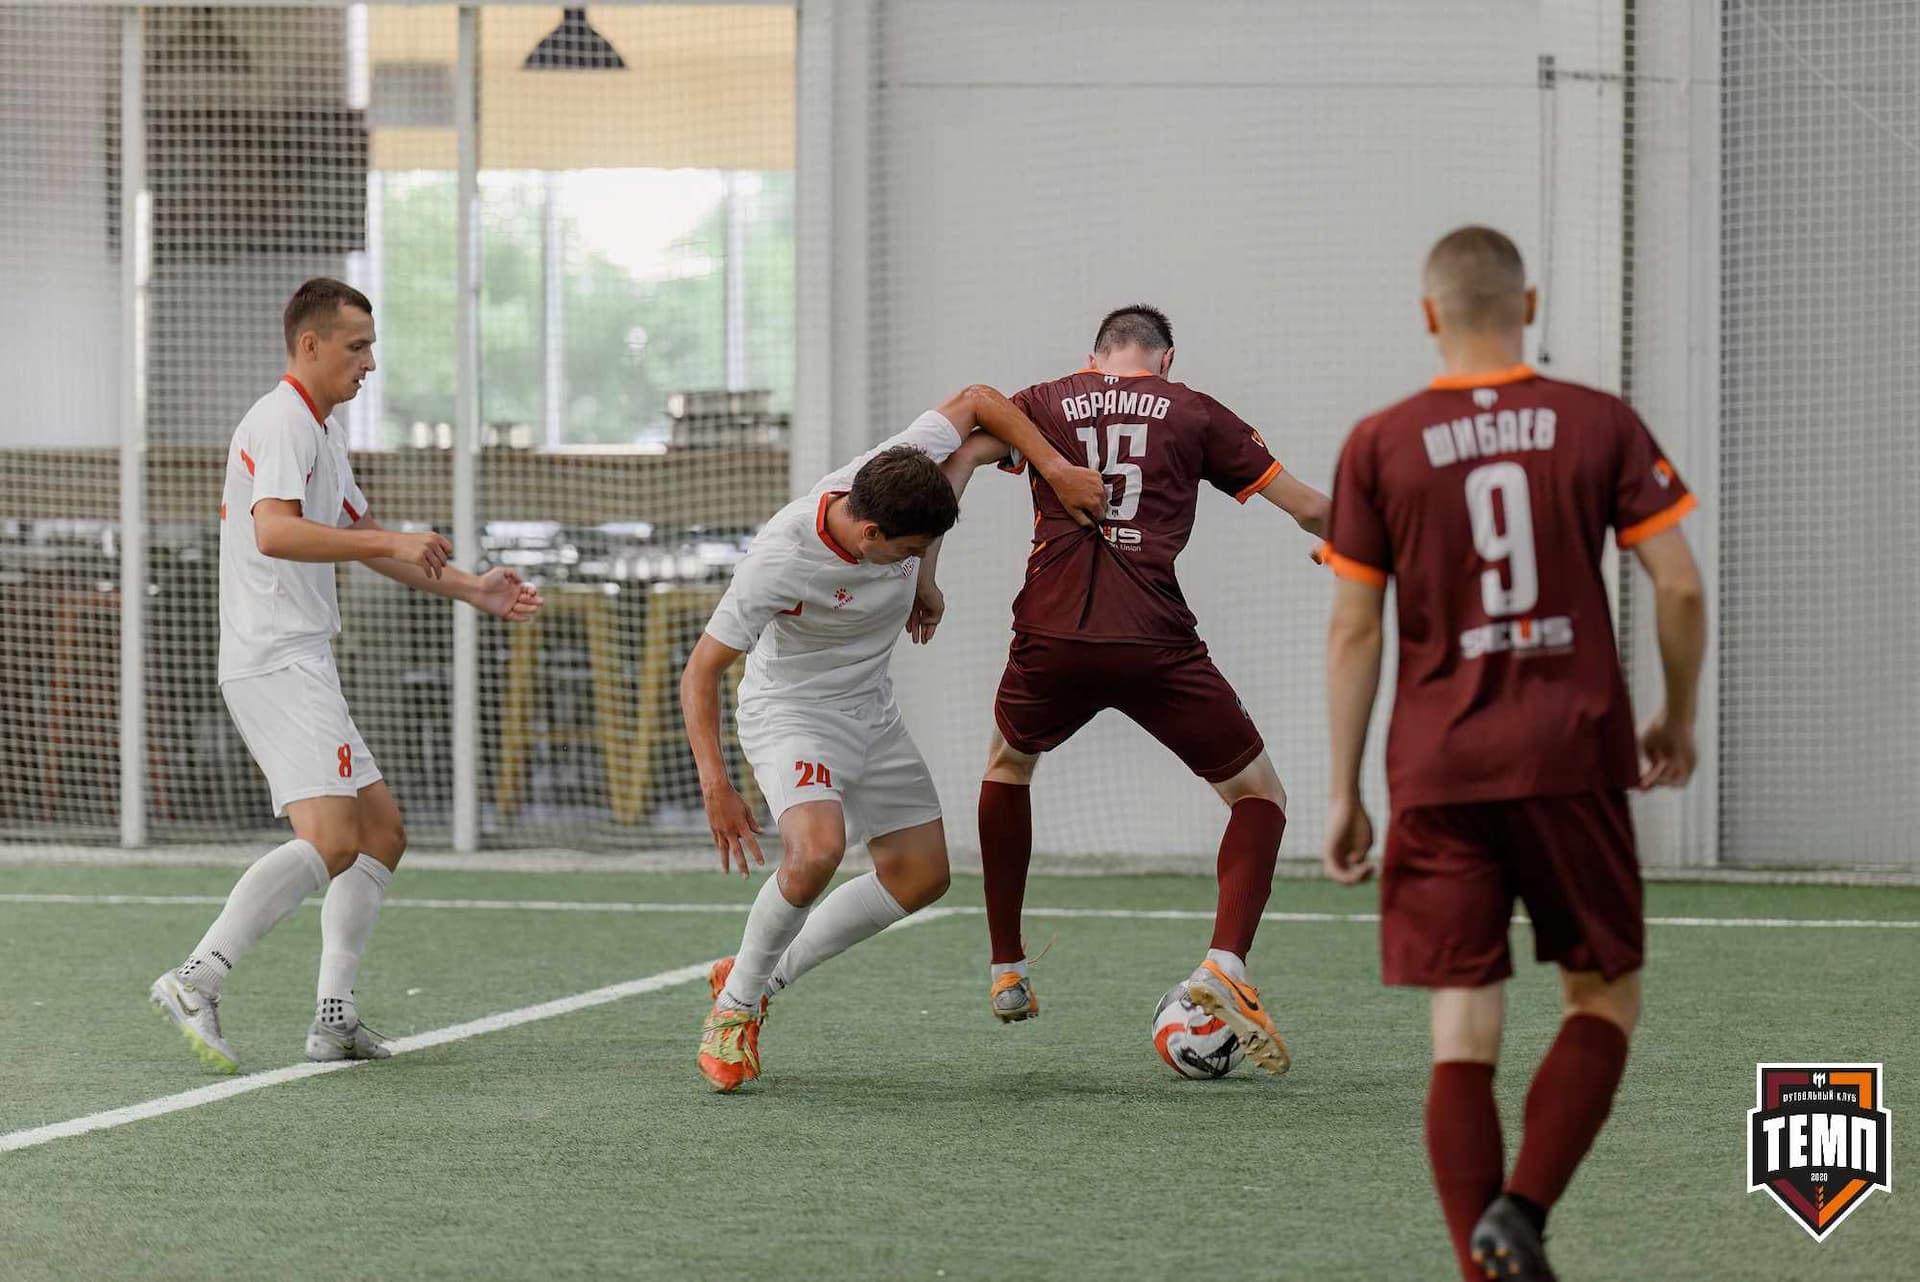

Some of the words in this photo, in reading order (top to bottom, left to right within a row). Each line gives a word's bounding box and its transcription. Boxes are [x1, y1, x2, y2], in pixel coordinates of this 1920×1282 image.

[1061, 389, 1171, 422] АБРАМОВ
[1423, 408, 1557, 469] ШИБАЕВ
[1075, 423, 1149, 521] 15
[1465, 460, 1539, 617] 9
[337, 743, 353, 778] 8
[794, 760, 833, 789] 24
